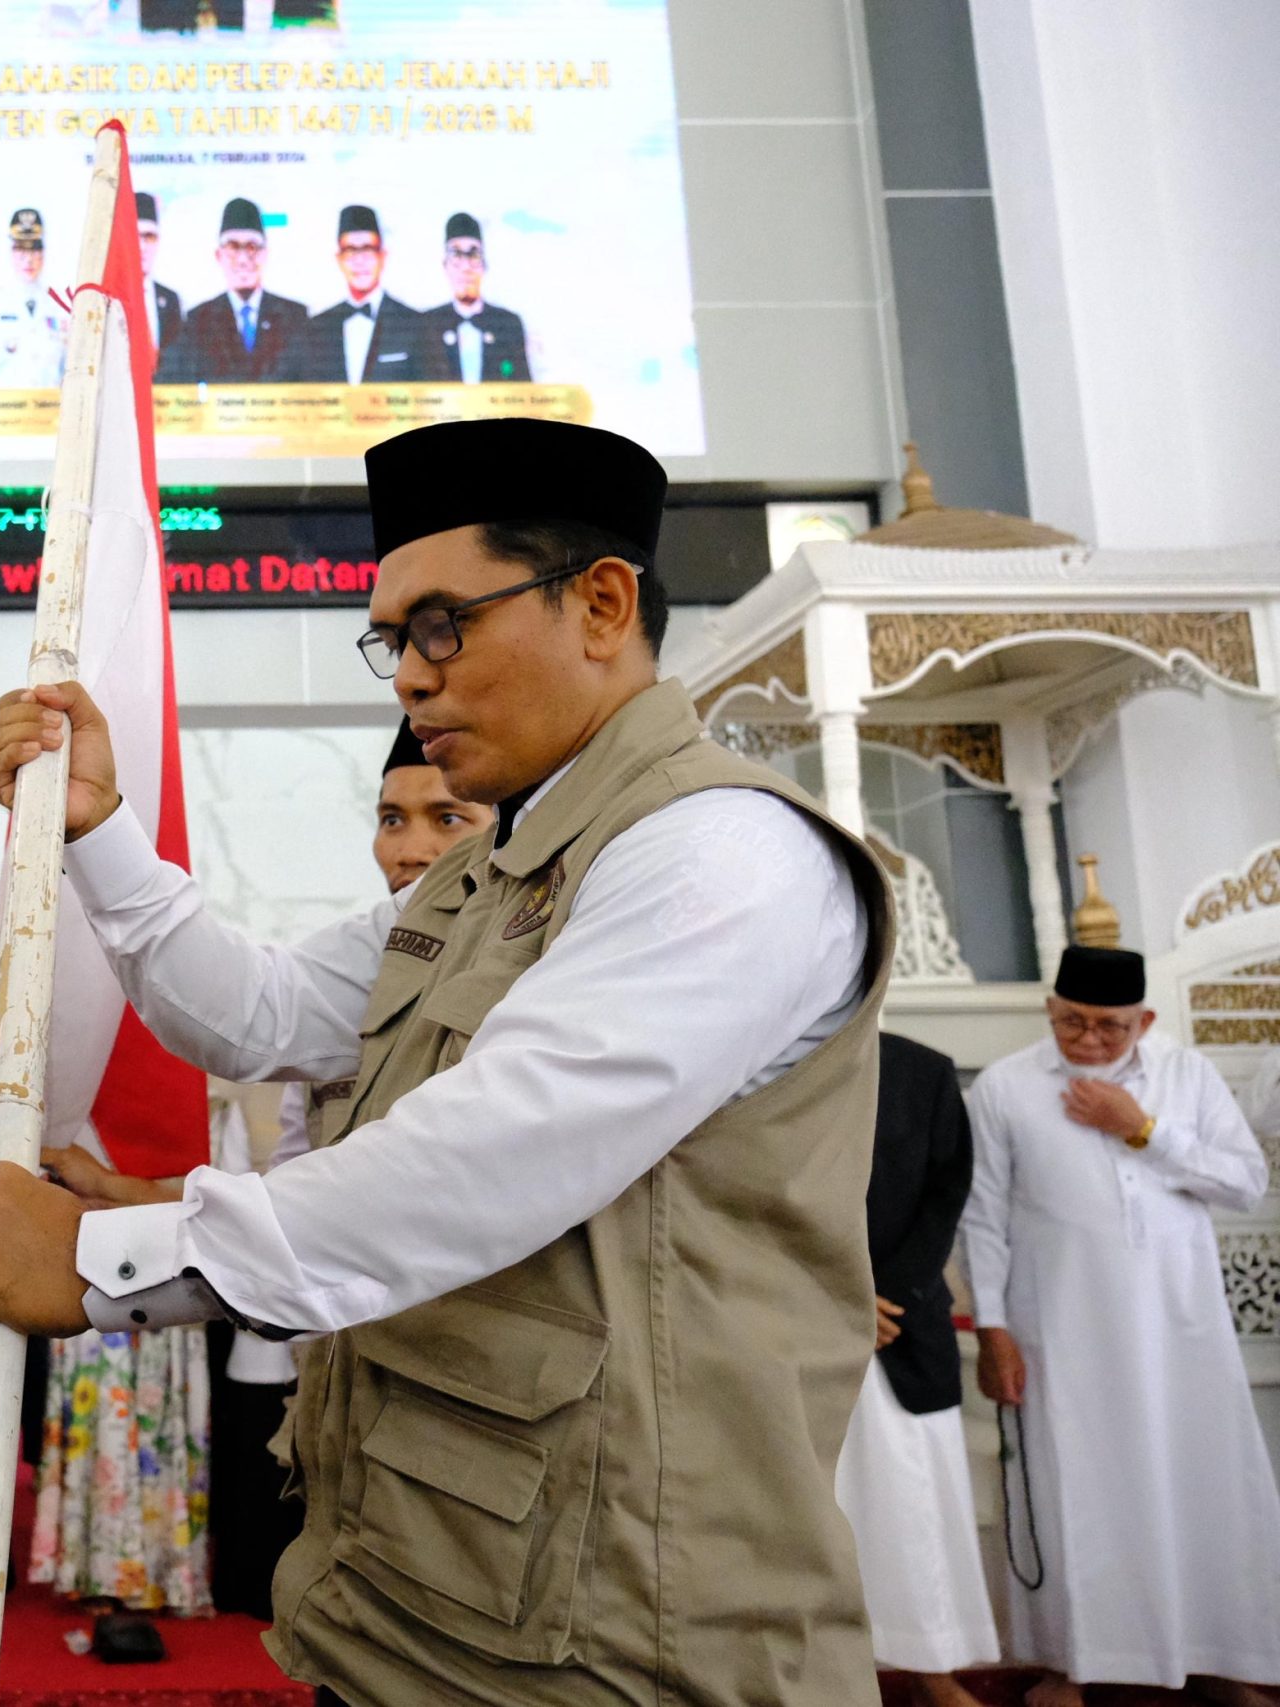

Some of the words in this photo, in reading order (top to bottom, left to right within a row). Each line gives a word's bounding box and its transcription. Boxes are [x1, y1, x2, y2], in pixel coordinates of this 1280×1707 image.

[128, 63, 197, 92] DAN
[206, 62, 385, 91] PELEPASAN
[394, 61, 526, 90] JEMAAH
[536, 61, 609, 89] HAJI
[55, 107, 161, 137] GOWA
[168, 106, 279, 136] TAHUN
[289, 105, 361, 135] 1447
[369, 105, 392, 133] H
[422, 104, 498, 132] 2026
[506, 104, 535, 132] M
[0, 556, 45, 593] w
[260, 554, 380, 592] Datan
